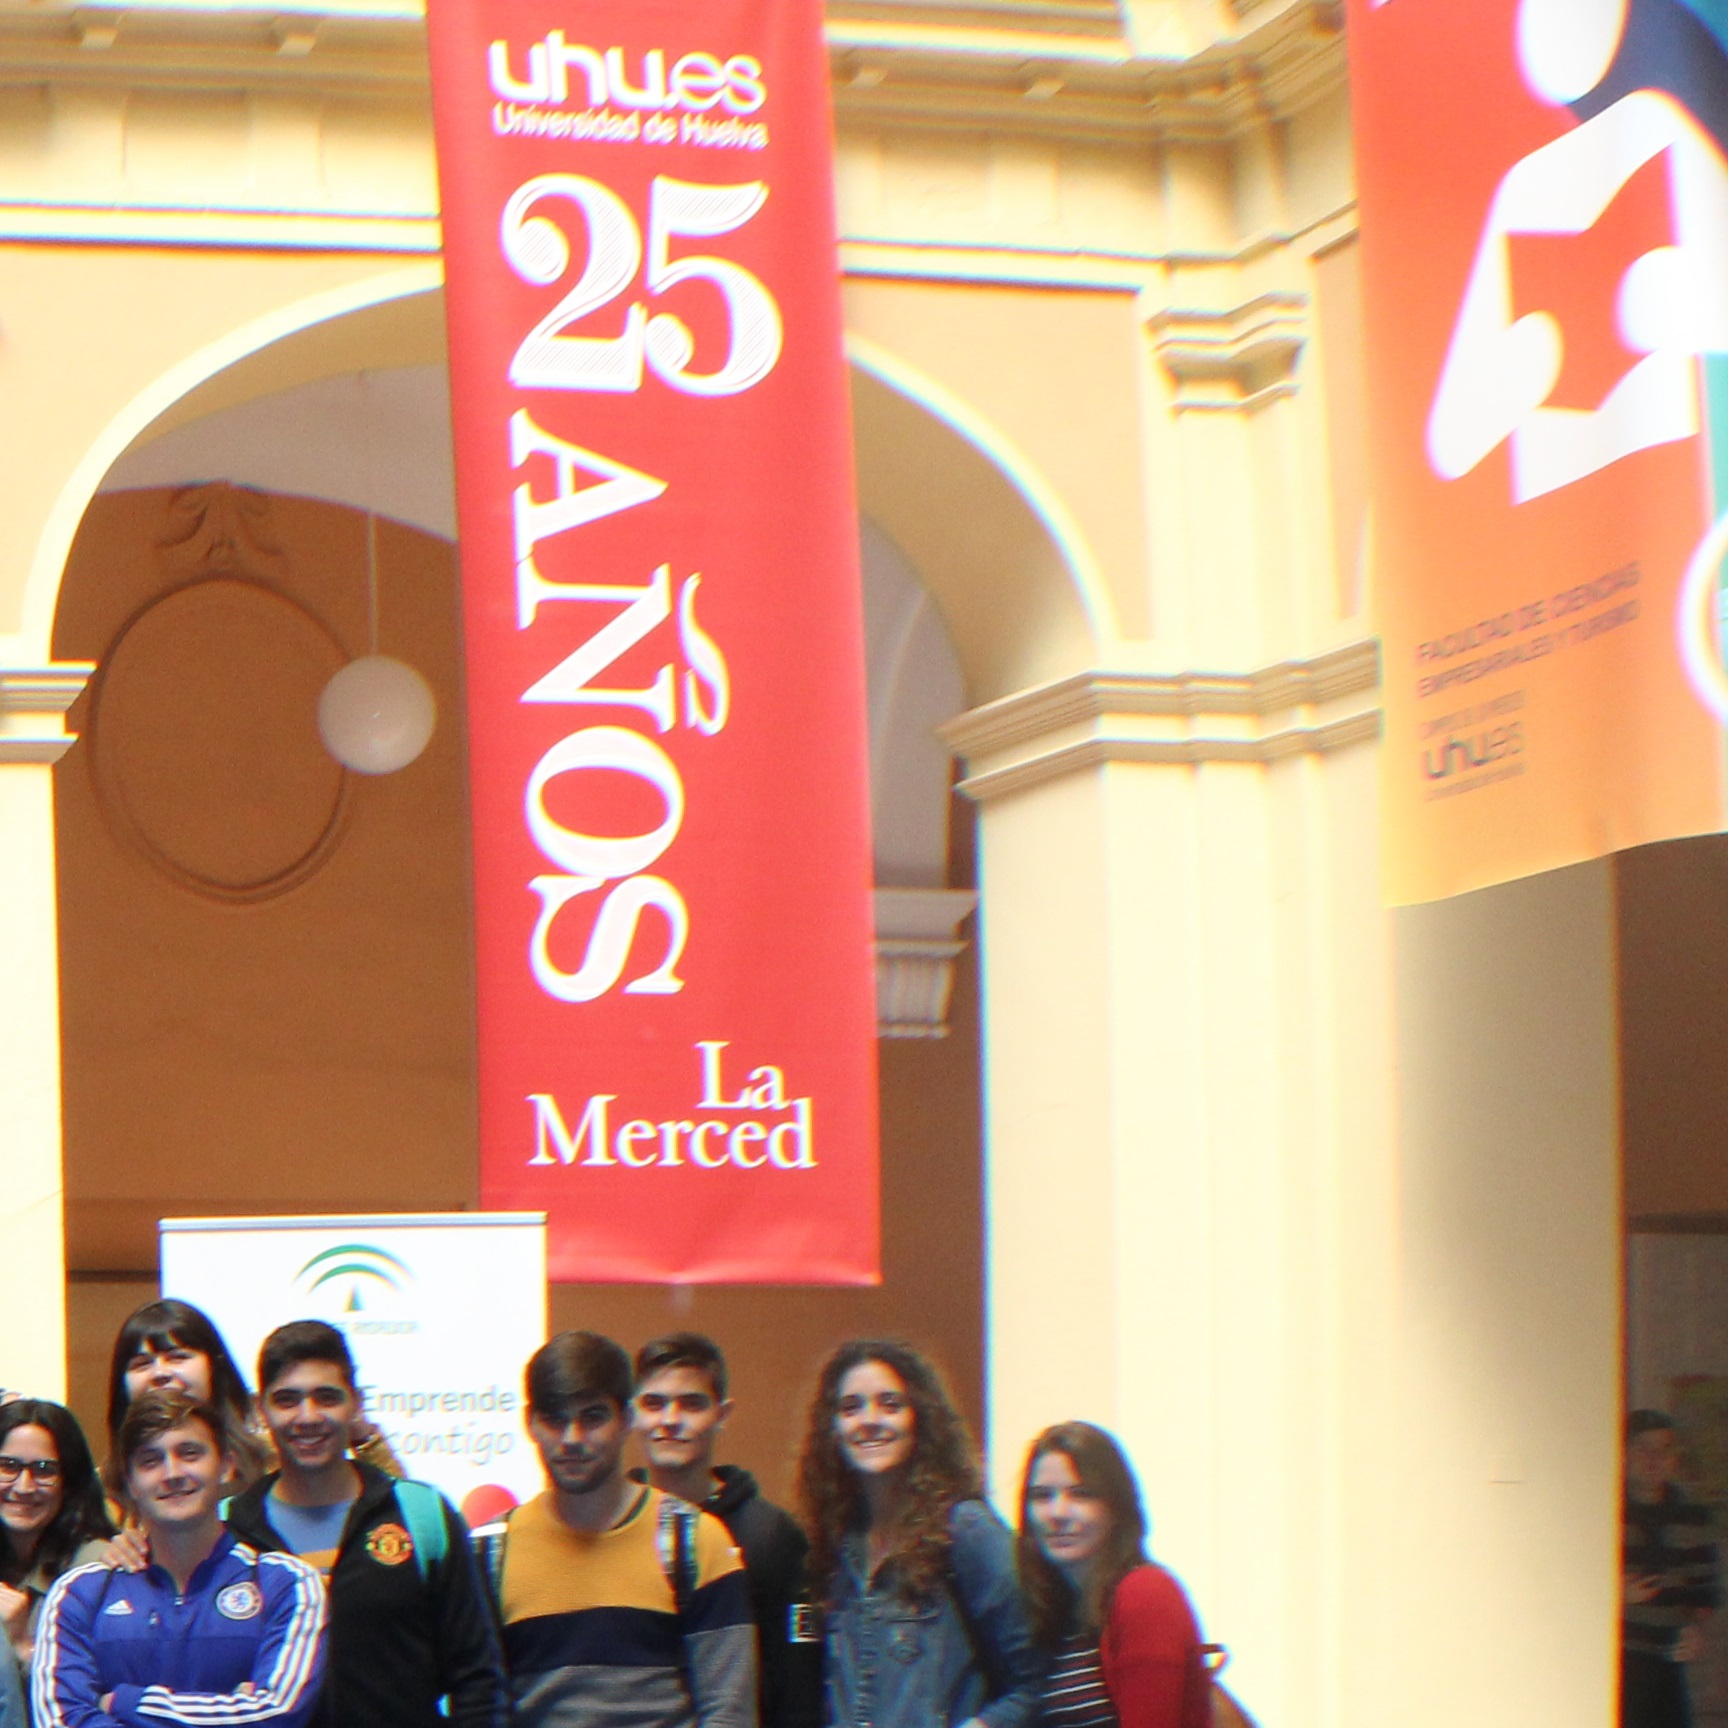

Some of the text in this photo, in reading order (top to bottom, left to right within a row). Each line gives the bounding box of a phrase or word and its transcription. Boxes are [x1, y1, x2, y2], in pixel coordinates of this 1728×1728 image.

[488, 29, 767, 116] uhu.es
[492, 101, 770, 151] Universidad de Huelva
[499, 173, 783, 396] 25
[510, 407, 730, 1003] AÑOS
[694, 1039, 786, 1110] La
[526, 1093, 817, 1169] Merced
